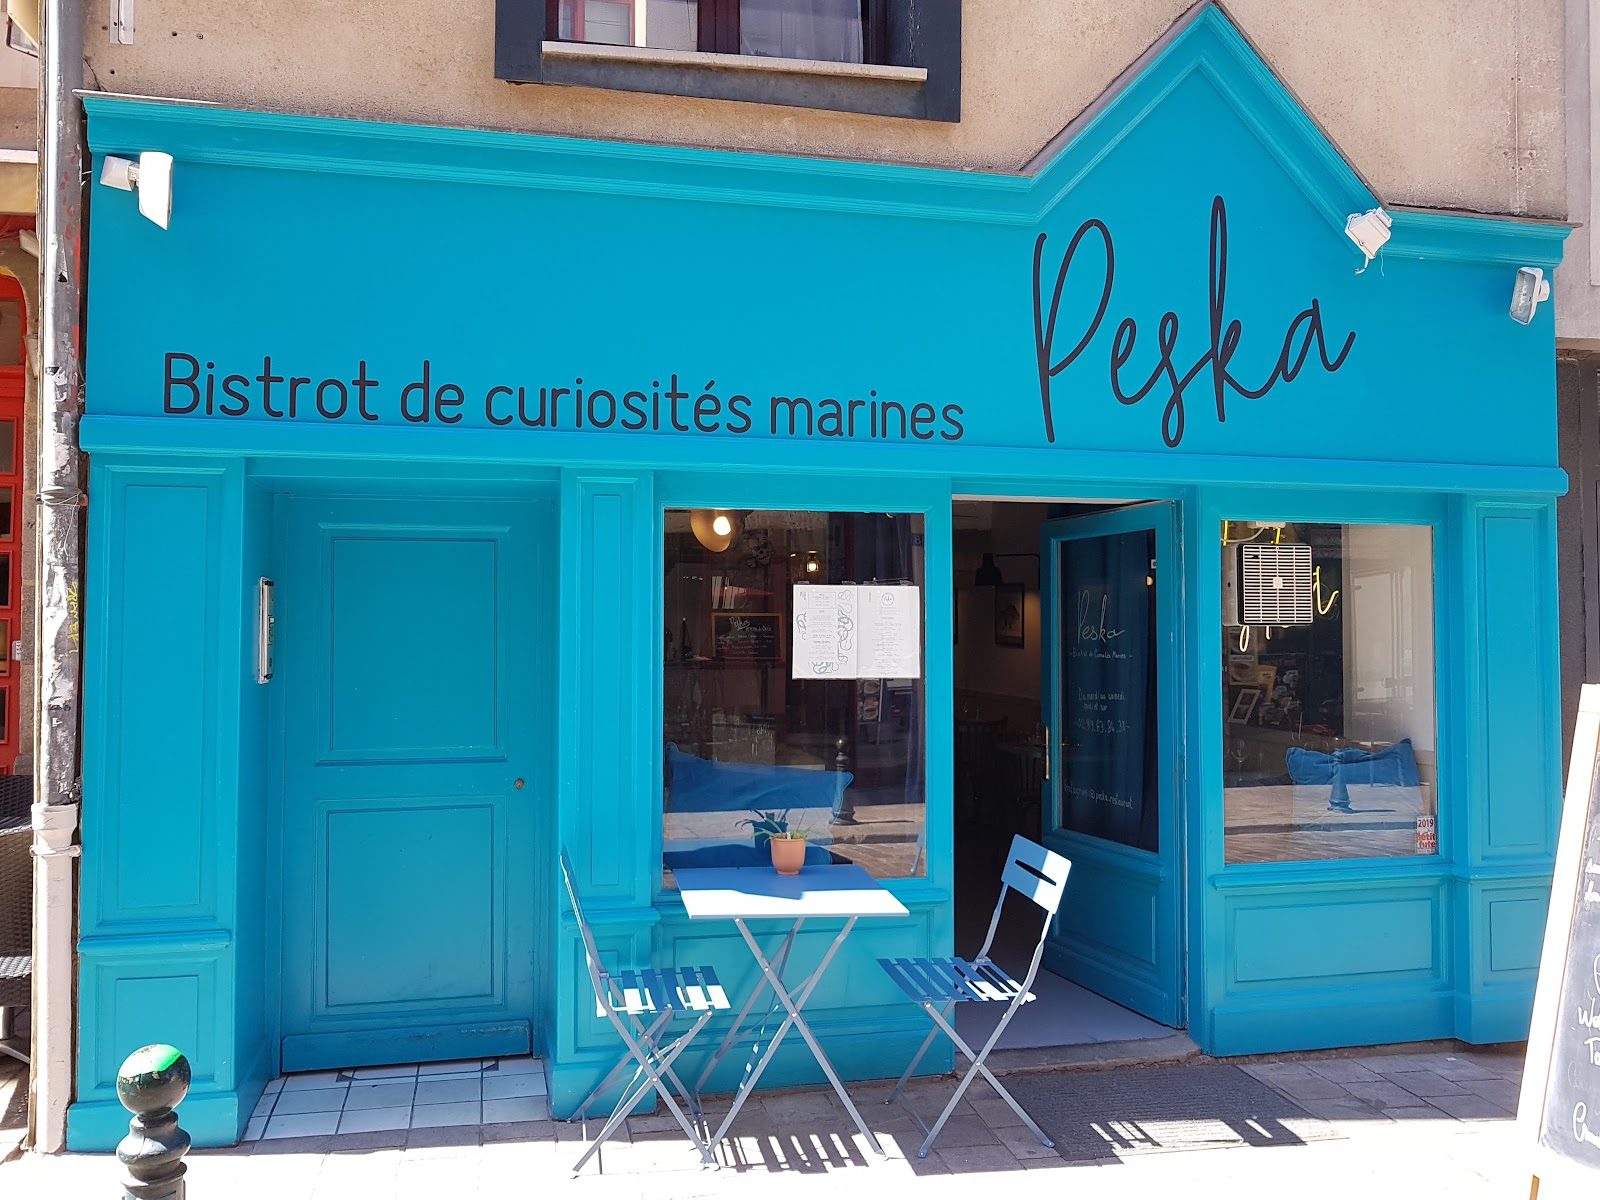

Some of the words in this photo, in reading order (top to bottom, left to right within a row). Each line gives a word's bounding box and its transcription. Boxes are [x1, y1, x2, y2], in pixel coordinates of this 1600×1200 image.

[1032, 195, 1357, 448] Peska
[163, 352, 380, 421] Bistrot
[400, 359, 465, 424] de
[485, 376, 752, 434] curiosités
[770, 390, 964, 441] marines
[1077, 589, 1125, 645] Peska
[1418, 818, 1433, 828] 2019
